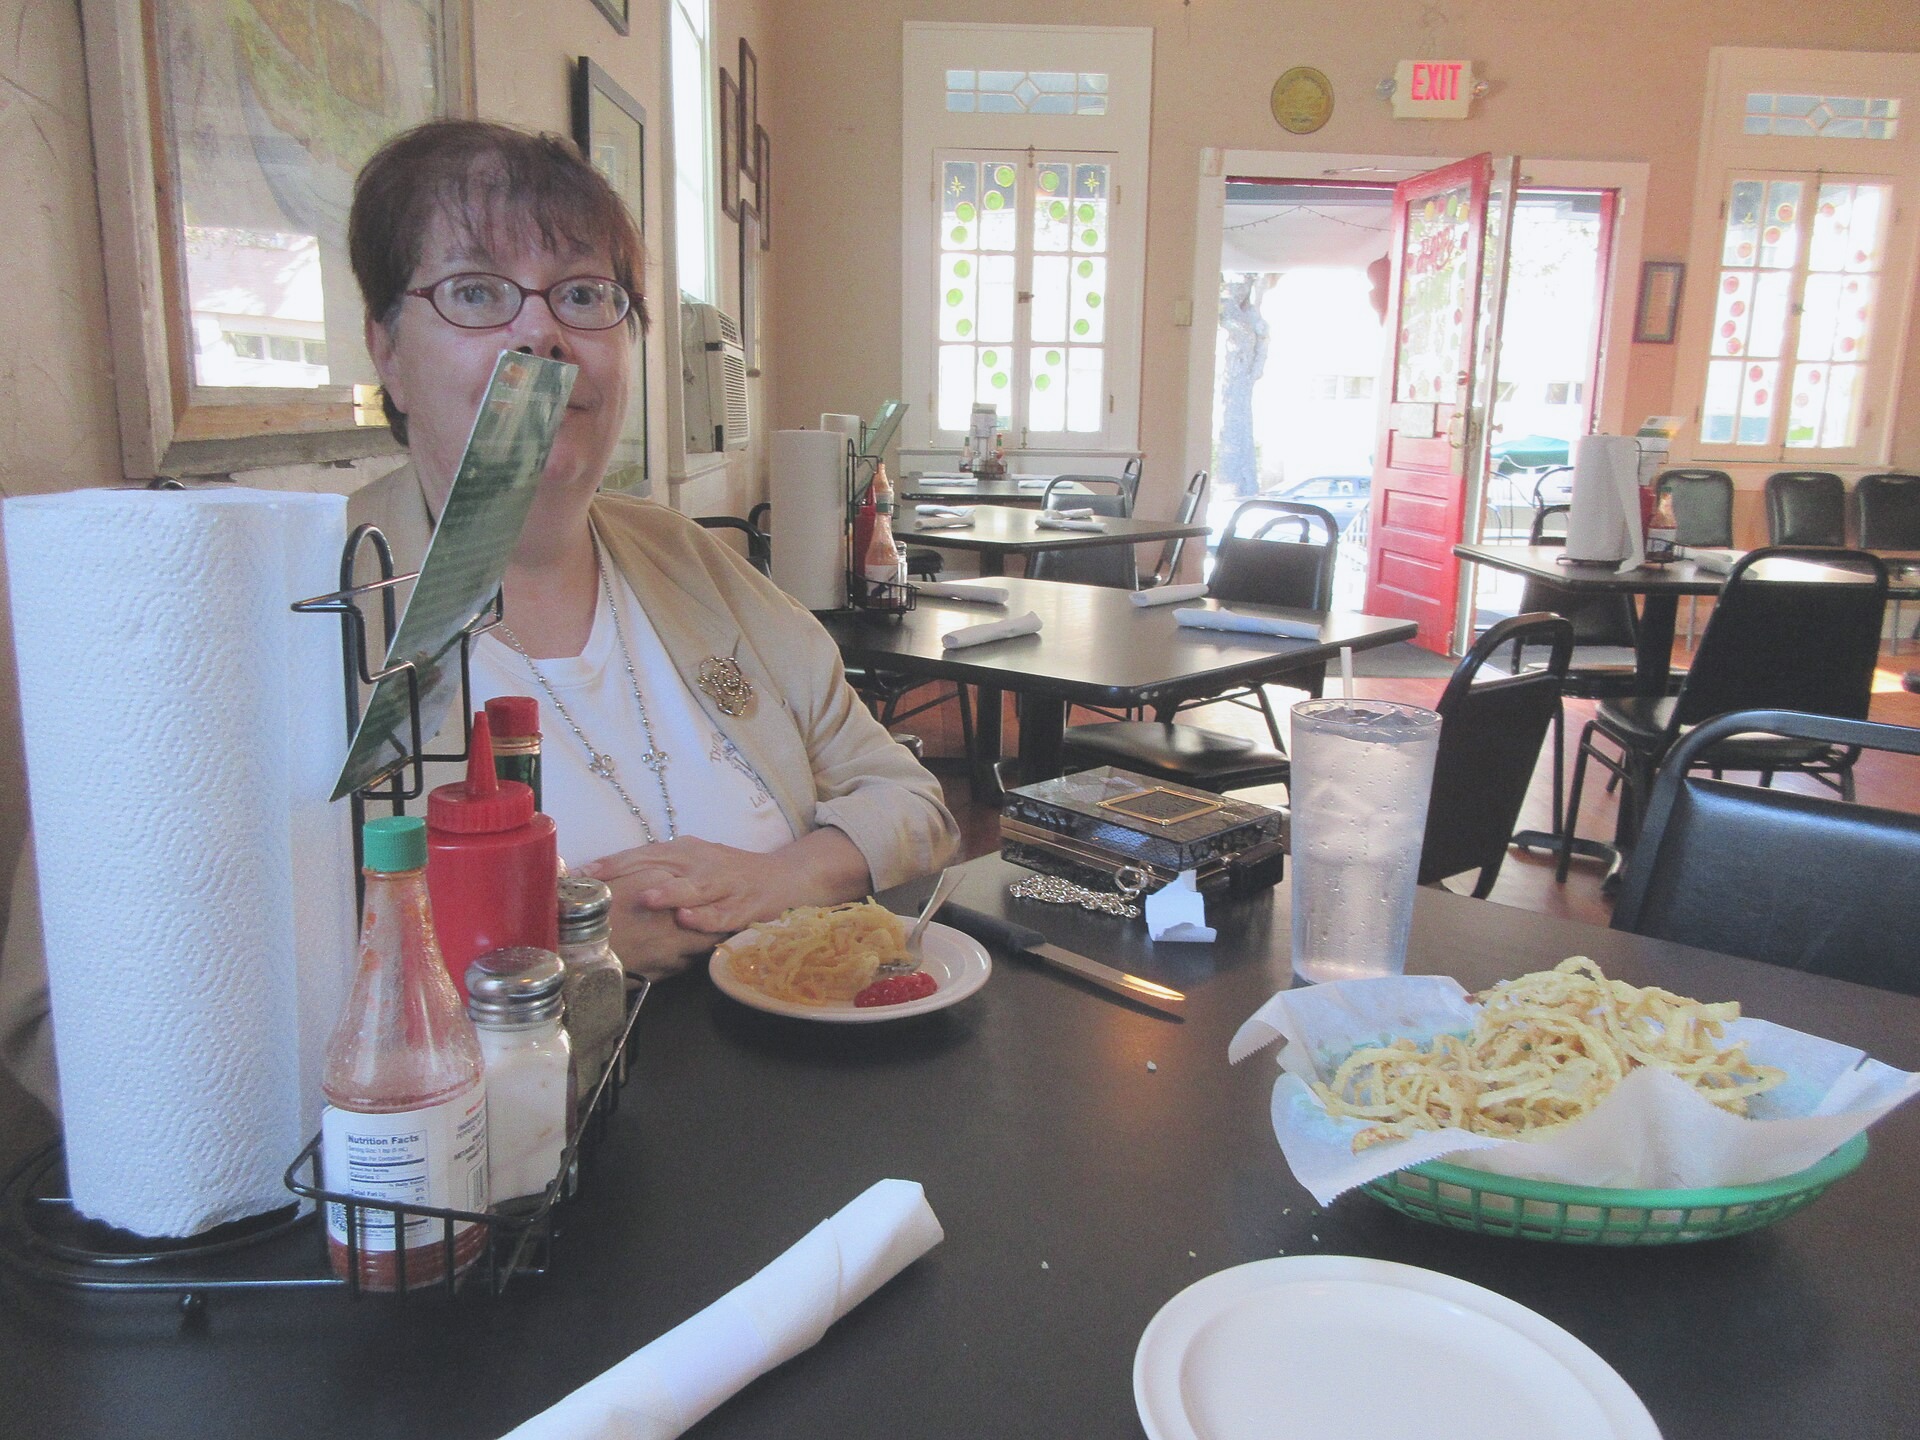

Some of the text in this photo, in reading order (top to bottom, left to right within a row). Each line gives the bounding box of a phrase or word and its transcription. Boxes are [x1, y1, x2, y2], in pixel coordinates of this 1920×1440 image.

[1411, 63, 1464, 101] EXIT
[348, 1135, 419, 1145] Nutrition Facts
